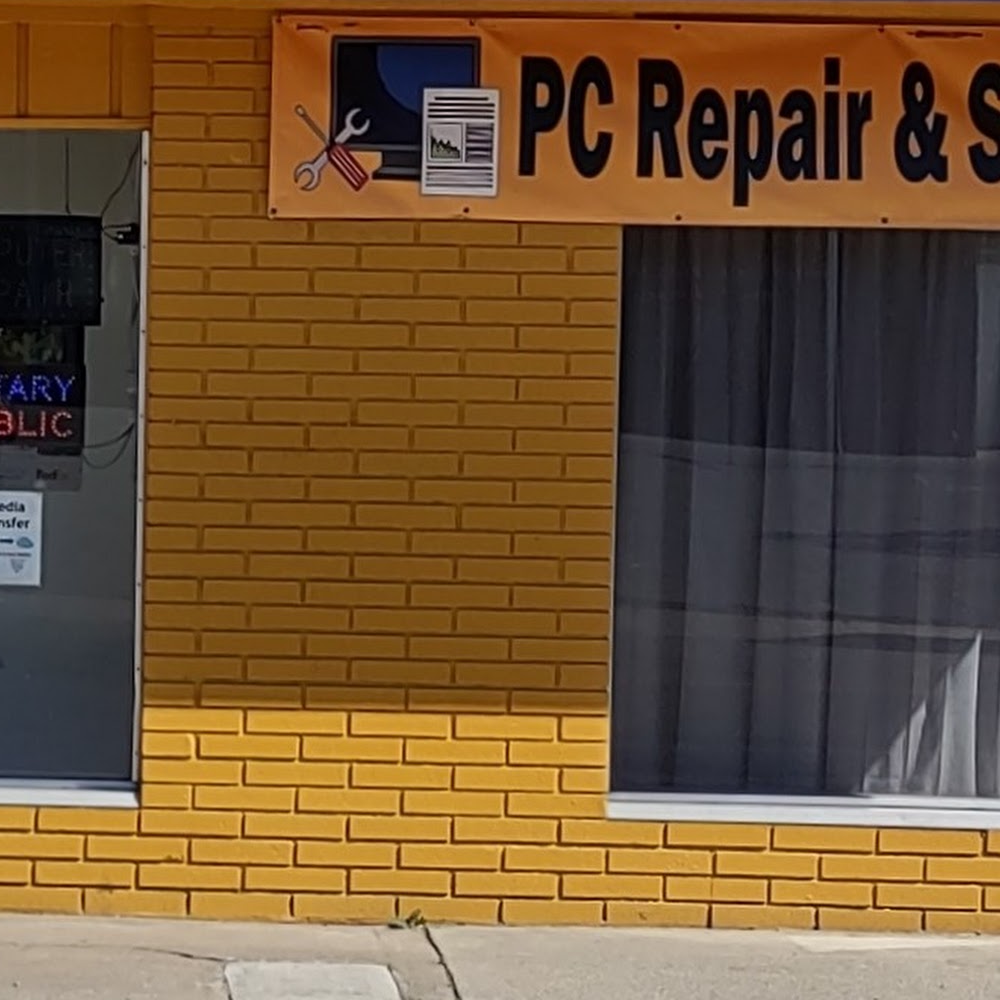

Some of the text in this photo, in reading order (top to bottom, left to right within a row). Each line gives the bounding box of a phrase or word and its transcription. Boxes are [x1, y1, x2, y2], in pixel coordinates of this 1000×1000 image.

[518, 55, 615, 179] PC
[636, 56, 873, 208] Repair
[894, 60, 949, 184] &
